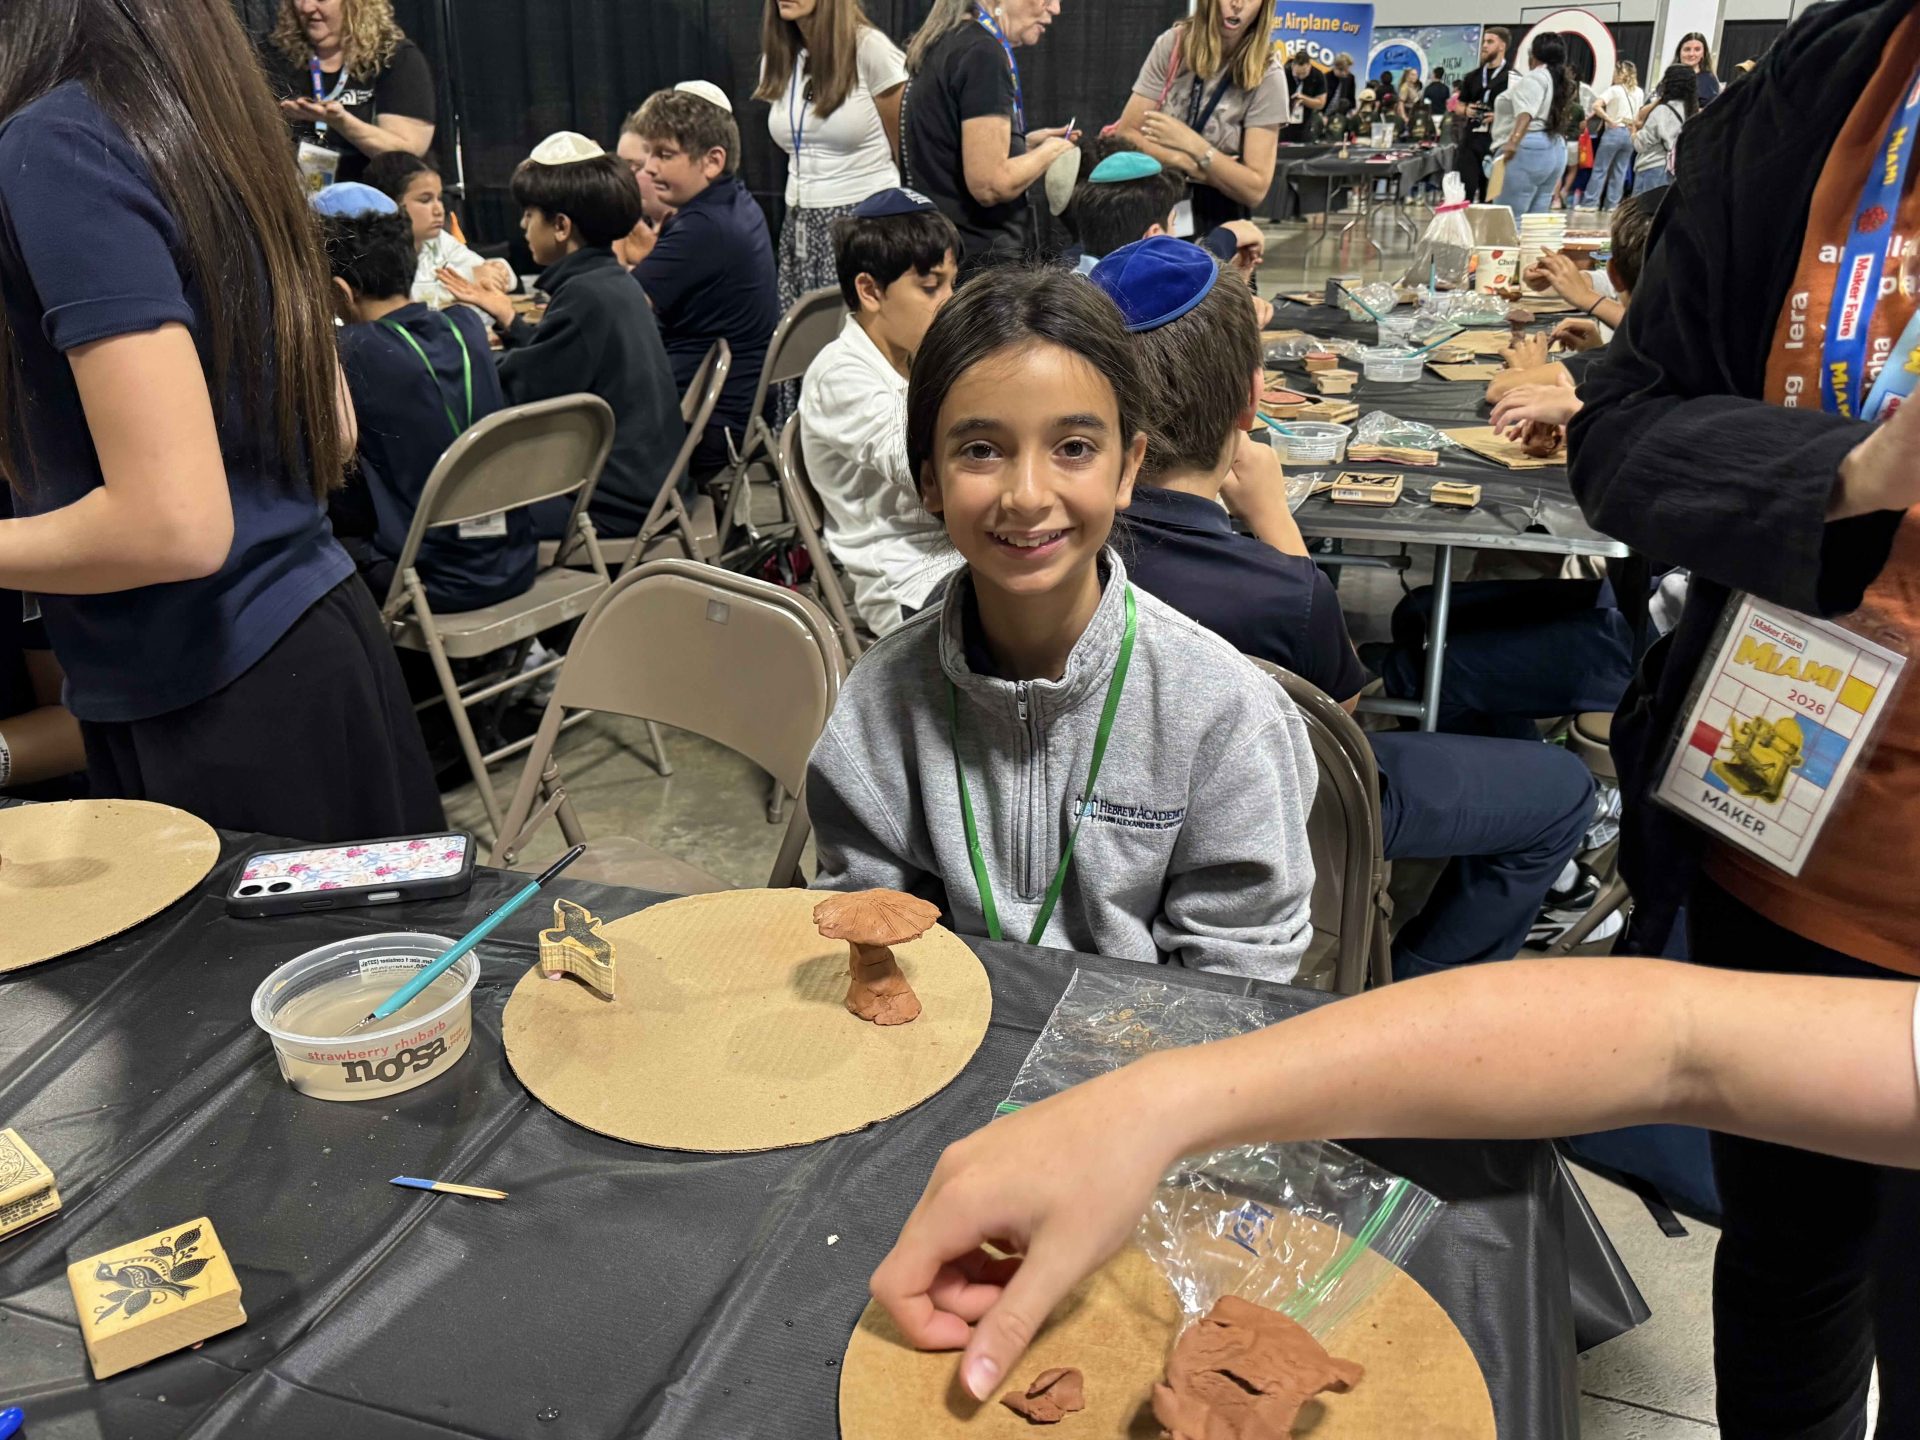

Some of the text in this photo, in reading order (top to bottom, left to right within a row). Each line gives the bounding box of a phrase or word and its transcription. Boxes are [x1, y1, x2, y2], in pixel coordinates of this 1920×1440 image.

[1285, 12, 1340, 34] Airplane
[1342, 21, 1360, 35] Guy
[1883, 126, 1909, 185] MIAMI
[1840, 257, 1870, 338] Maker Faire
[1753, 619, 1803, 649] Maker Faire
[1733, 634, 1844, 692] MIAMI
[1787, 688, 1826, 715] 2026
[1701, 790, 1766, 835] MAKER
[308, 1046, 389, 1061] strawberry
[395, 1020, 446, 1051] rhubarb
[342, 1037, 448, 1083] noosa
